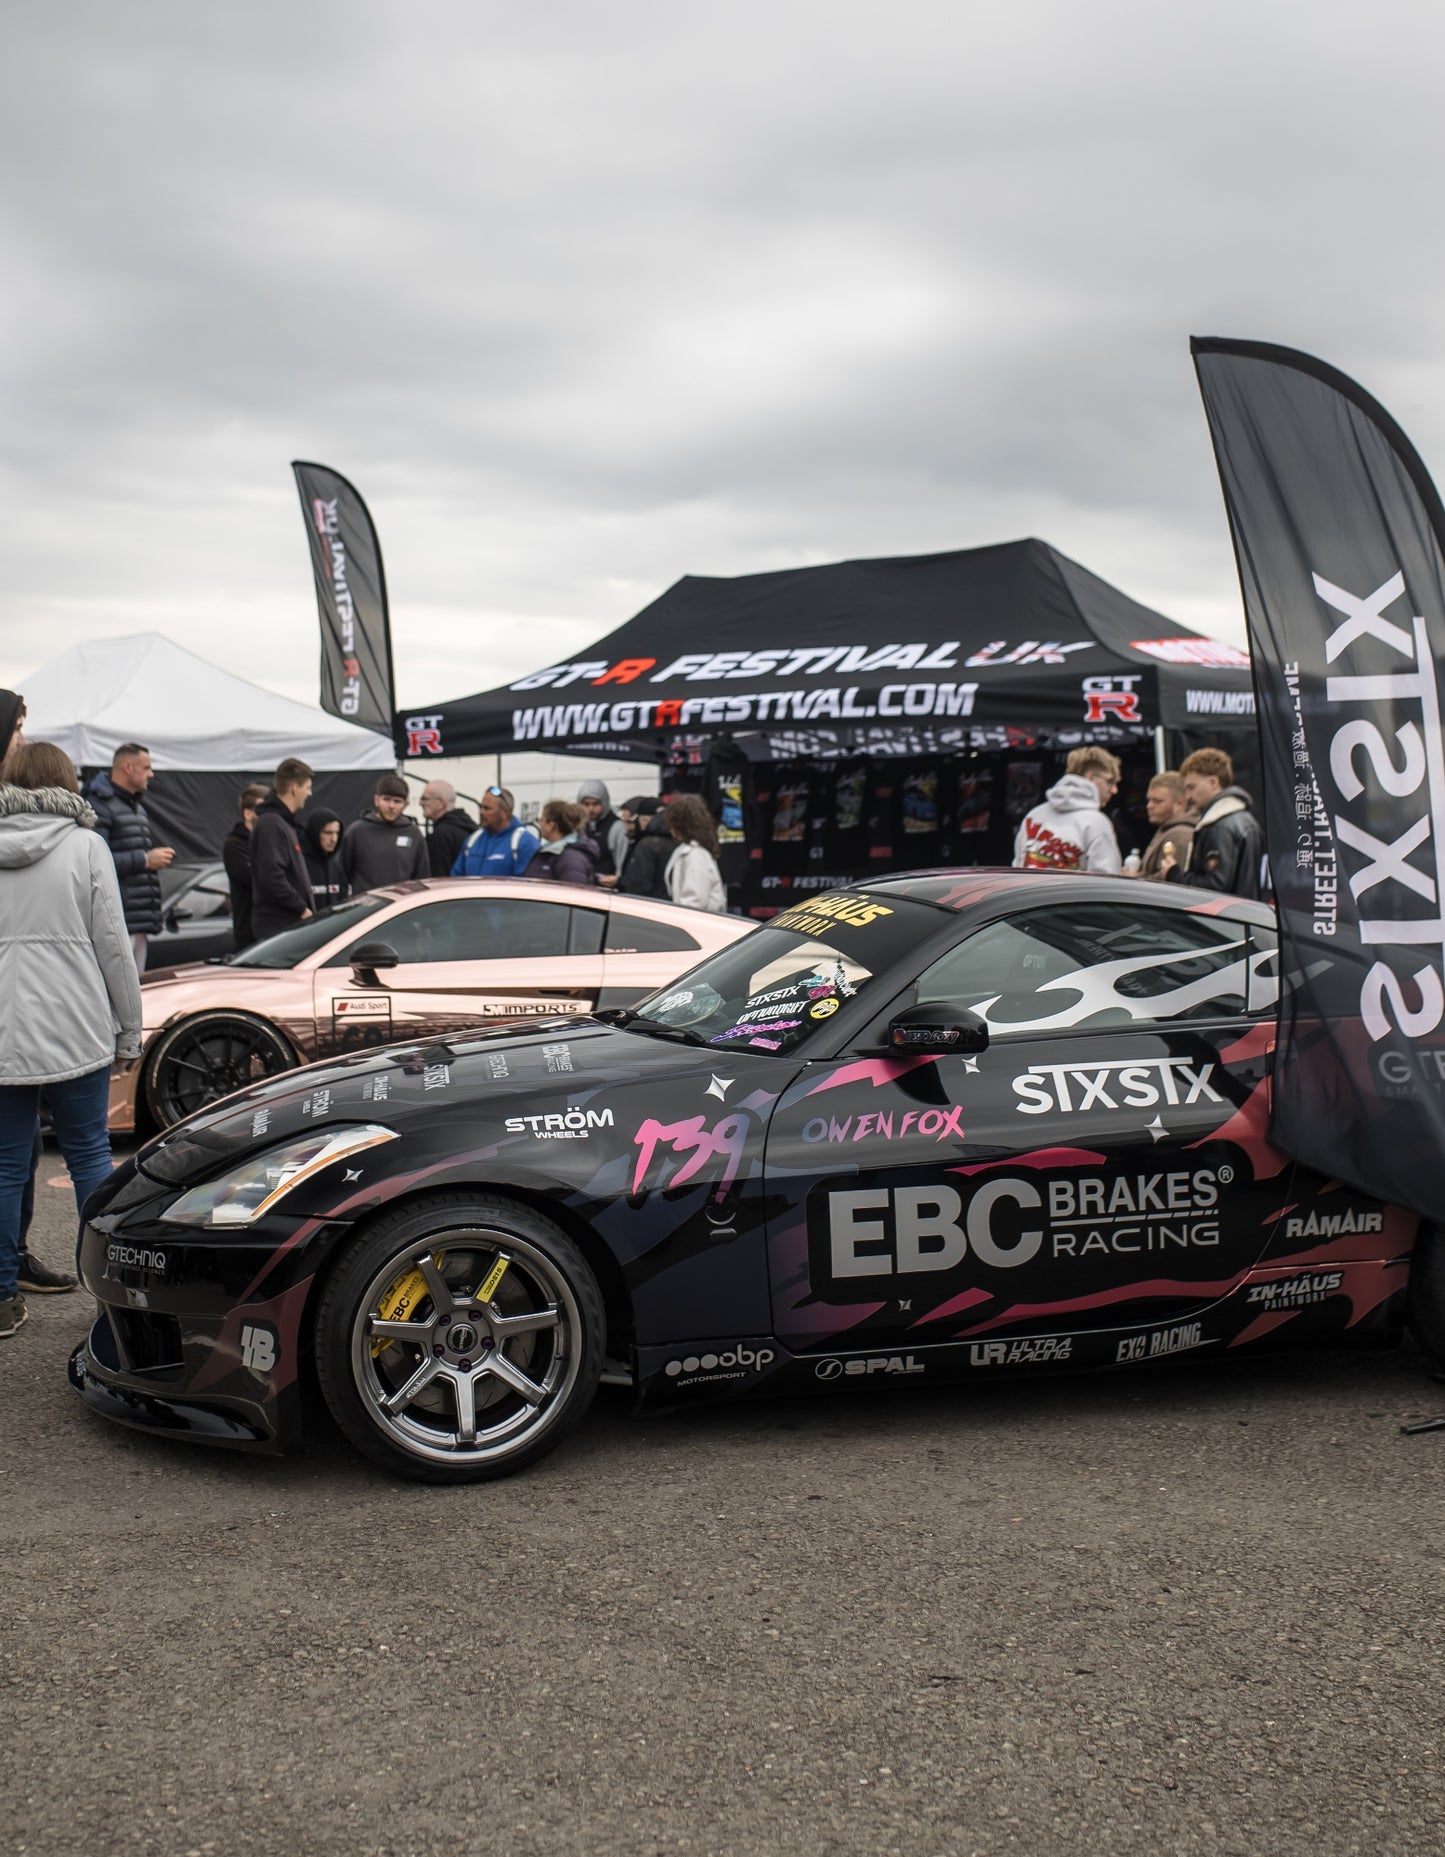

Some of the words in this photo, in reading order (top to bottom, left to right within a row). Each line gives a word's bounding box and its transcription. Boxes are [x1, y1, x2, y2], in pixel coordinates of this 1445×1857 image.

[509, 658, 656, 690] GT-R
[649, 641, 961, 683] FESTIVAL
[1082, 674, 1142, 692] GT
[405, 715, 443, 730] GT
[512, 682, 979, 740] WWW.GTRFESTIVAL.COM
[350, 1002, 366, 1010] Audi
[368, 1002, 388, 1011] Sport
[505, 1106, 614, 1132] STRÖM
[801, 1110, 894, 1143] OWEN
[899, 1104, 966, 1143] FOX
[534, 1130, 589, 1139] WHEELS
[829, 1178, 1043, 1278] EBC
[1286, 1207, 1383, 1238] RAMAIR
[1052, 1221, 1219, 1258] RACING
[107, 1244, 166, 1270] GTECHNIQ
[1247, 1273, 1343, 1303] IN-HÄUS
[1264, 1291, 1327, 1311] PAINTWORX
[1011, 1337, 1072, 1353] ULTRA
[1150, 1322, 1202, 1355] RACING
[845, 1355, 925, 1375] SPAL
[1006, 1347, 1072, 1365] RACING
[677, 1371, 747, 1388] MOTORSPORT
